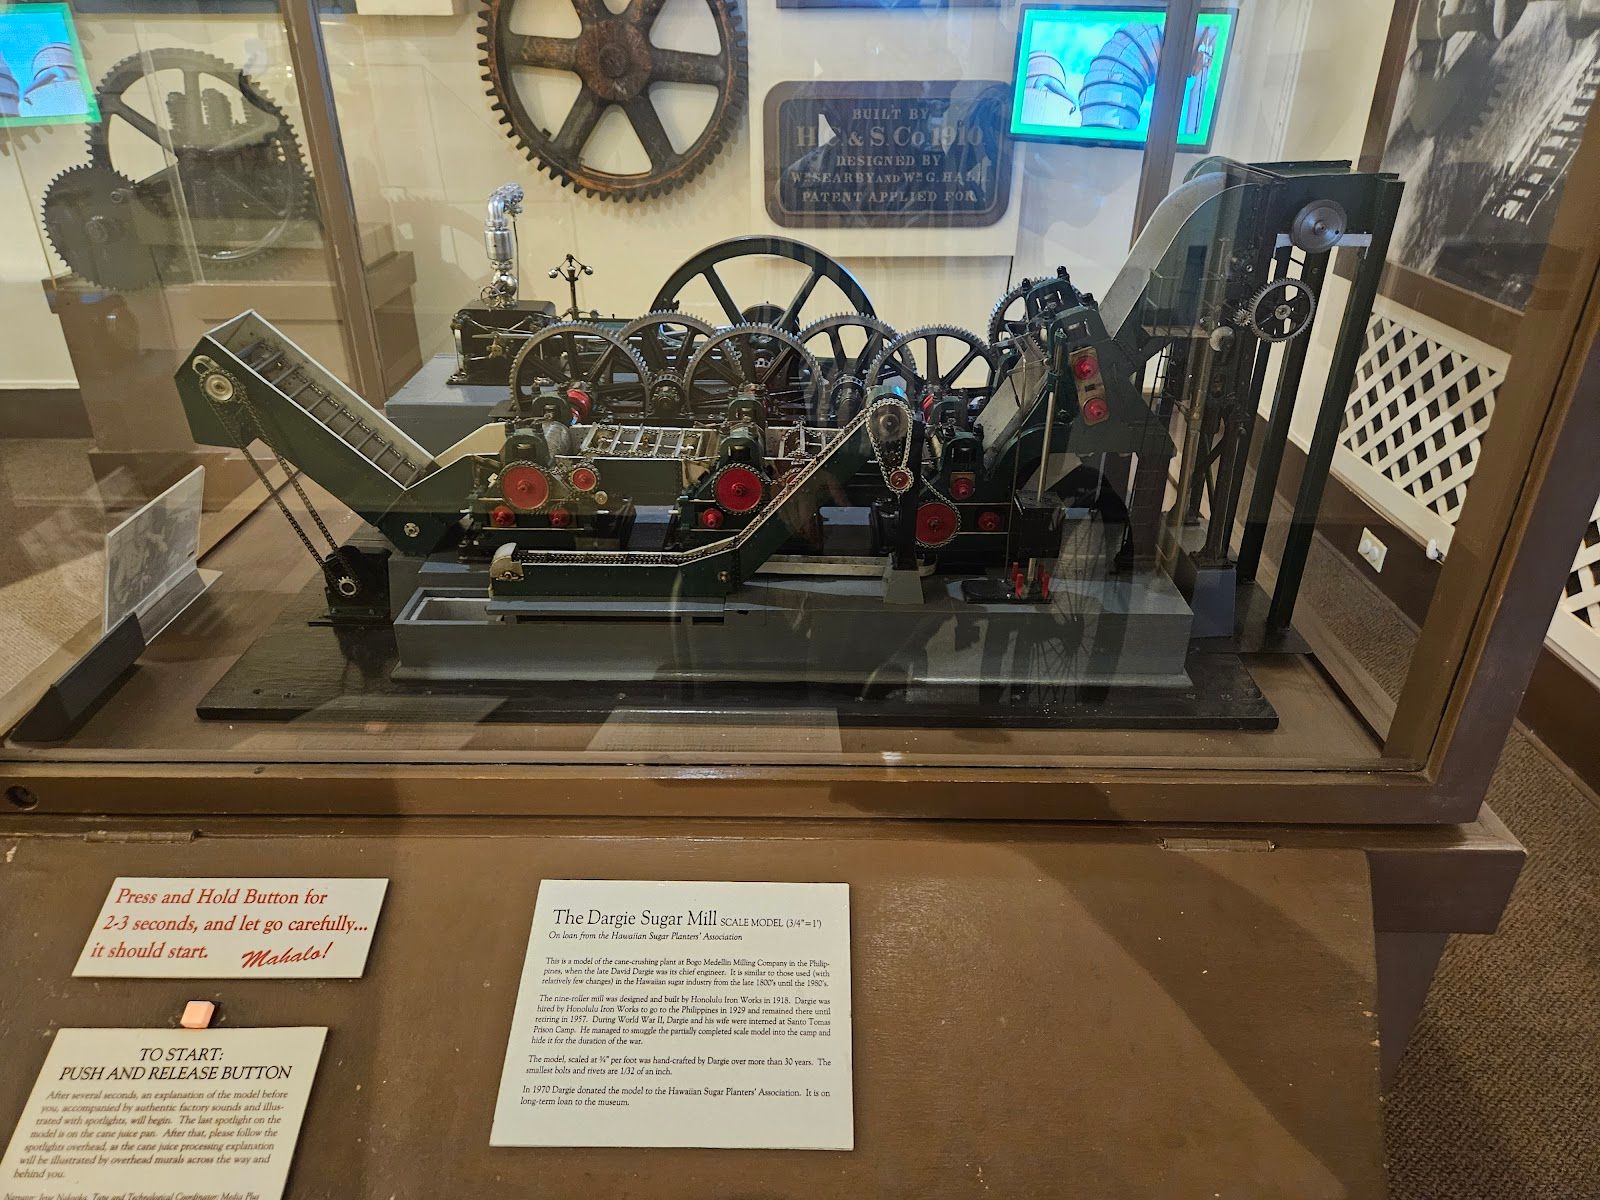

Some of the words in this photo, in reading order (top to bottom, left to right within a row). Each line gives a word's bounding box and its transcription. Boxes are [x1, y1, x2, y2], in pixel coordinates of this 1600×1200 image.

[852, 107, 902, 120] BUILT
[908, 107, 930, 120] BY
[836, 154, 916, 167] DESIGNED
[921, 154, 942, 167] BY
[876, 174, 900, 184] AND
[801, 190, 863, 203] PATENT
[868, 191, 937, 203] APPLIED
[114, 887, 158, 904] Press
[160, 887, 195, 904] and
[195, 887, 241, 905] Hold
[242, 888, 299, 905] Button
[303, 888, 329, 905] for
[101, 914, 130, 931] 2-3
[131, 913, 198, 934] seconds,
[202, 914, 238, 931] and
[237, 913, 262, 931] let
[261, 919, 284, 935] go
[287, 913, 368, 935] carefully...
[552, 908, 584, 925] The
[586, 908, 636, 929] Dargie
[640, 909, 684, 930] Sugar
[686, 909, 717, 926] Mill
[719, 917, 749, 927] SCALE
[750, 918, 784, 928] MODEL
[548, 930, 561, 939] On
[562, 930, 578, 939] loan
[578, 930, 596, 941] from
[598, 930, 610, 940] the
[610, 930, 647, 940] Hawaiian
[648, 931, 670, 942] Sugar
[702, 932, 743, 941] Association
[89, 941, 106, 958] it
[106, 940, 167, 959] should
[167, 945, 209, 959] start.
[240, 940, 334, 969] Mahalo!
[538, 993, 553, 1002] The
[553, 994, 589, 1002] nine-roller
[590, 994, 605, 1003] mill
[619, 994, 649, 1004] designed
[649, 994, 663, 1003] and
[663, 995, 680, 1003] built
[680, 994, 690, 1004] by
[690, 995, 723, 1004] Honolulu
[724, 995, 739, 1004] Iron
[739, 995, 762, 1004] Works
[773, 996, 791, 1005] 1918.
[794, 996, 817, 1006] Dargie
[536, 1004, 556, 1013] hired
[556, 1004, 565, 1014] by
[565, 1004, 599, 1013] Honolulu
[599, 1004, 615, 1013] Iron
[616, 1004, 639, 1013] Works
[649, 1007, 658, 1015] go
[668, 1005, 680, 1014] the
[681, 1005, 719, 1016] Philippines
[719, 1006, 728, 1014] in
[729, 1006, 746, 1014] 1929
[747, 1006, 761, 1014] and
[761, 1006, 794, 1015] remained
[795, 1006, 813, 1015] there
[814, 1006, 831, 1016] until
[139, 1047, 164, 1062] TO
[164, 1047, 224, 1062] START:
[527, 1054, 542, 1063] The
[543, 1054, 567, 1063] model,
[567, 1054, 590, 1064] scaled
[609, 1057, 622, 1066] per
[622, 1055, 637, 1064] foot
[652, 1055, 697, 1065] hand-crafted
[697, 1055, 706, 1066] by
[706, 1056, 730, 1067] Dargie
[766, 1056, 783, 1066] than
[784, 1057, 794, 1066] 30
[816, 1057, 832, 1066] The
[58, 1066, 106, 1081] PUSH
[104, 1065, 147, 1081] AND
[147, 1065, 220, 1081] RELEASE
[219, 1064, 293, 1080] BUTTON
[525, 1065, 553, 1074] smallest
[554, 1065, 571, 1074] bolts
[572, 1065, 586, 1075] and
[586, 1067, 606, 1075] rivets
[620, 1066, 635, 1075] 1/32
[636, 1066, 645, 1075] of
[655, 1066, 673, 1075] inch.
[46, 1090, 70, 1100] After
[71, 1090, 103, 1099] several
[153, 1090, 205, 1101] explanation
[206, 1089, 218, 1099] of
[217, 1089, 232, 1099] the
[233, 1089, 261, 1099] model
[261, 1089, 289, 1099] before
[522, 1084, 531, 1093] In
[532, 1084, 551, 1094] 1970
[551, 1085, 576, 1096] Dargie
[576, 1085, 607, 1095] donated
[607, 1085, 620, 1095] the
[621, 1085, 644, 1095] model
[654, 1086, 667, 1095] the
[667, 1086, 702, 1096] Hawaiian
[703, 1086, 724, 1098] Sugar
[757, 1087, 802, 1097] Association.
[805, 1088, 812, 1097] It
[813, 1089, 820, 1097] is
[61, 1102, 122, 1114] accompanied
[121, 1102, 134, 1113] by
[134, 1102, 177, 1112] authentic
[178, 1102, 210, 1113] factory
[211, 1102, 242, 1112] sounds
[243, 1101, 262, 1111] and
[520, 1096, 556, 1107] long-term
[557, 1096, 573, 1105] loan
[584, 1096, 596, 1106] the
[12, 1168, 47, 1178] behind
